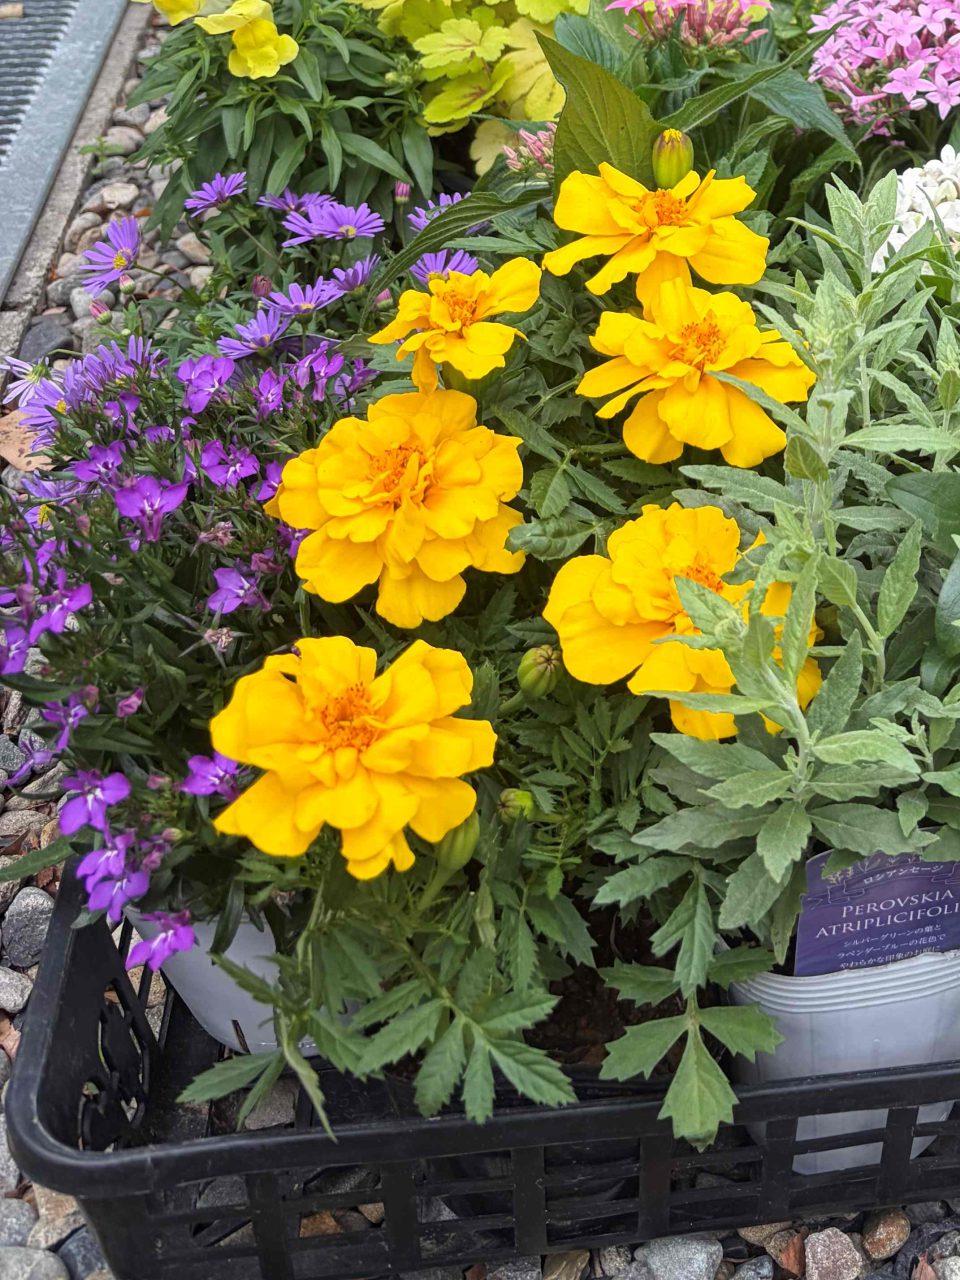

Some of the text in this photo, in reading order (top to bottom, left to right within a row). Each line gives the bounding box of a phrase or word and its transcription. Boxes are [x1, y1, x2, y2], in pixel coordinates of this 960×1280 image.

[863, 865, 944, 884] ロシアンセージ
[842, 889, 954, 918] PEROVSKIA
